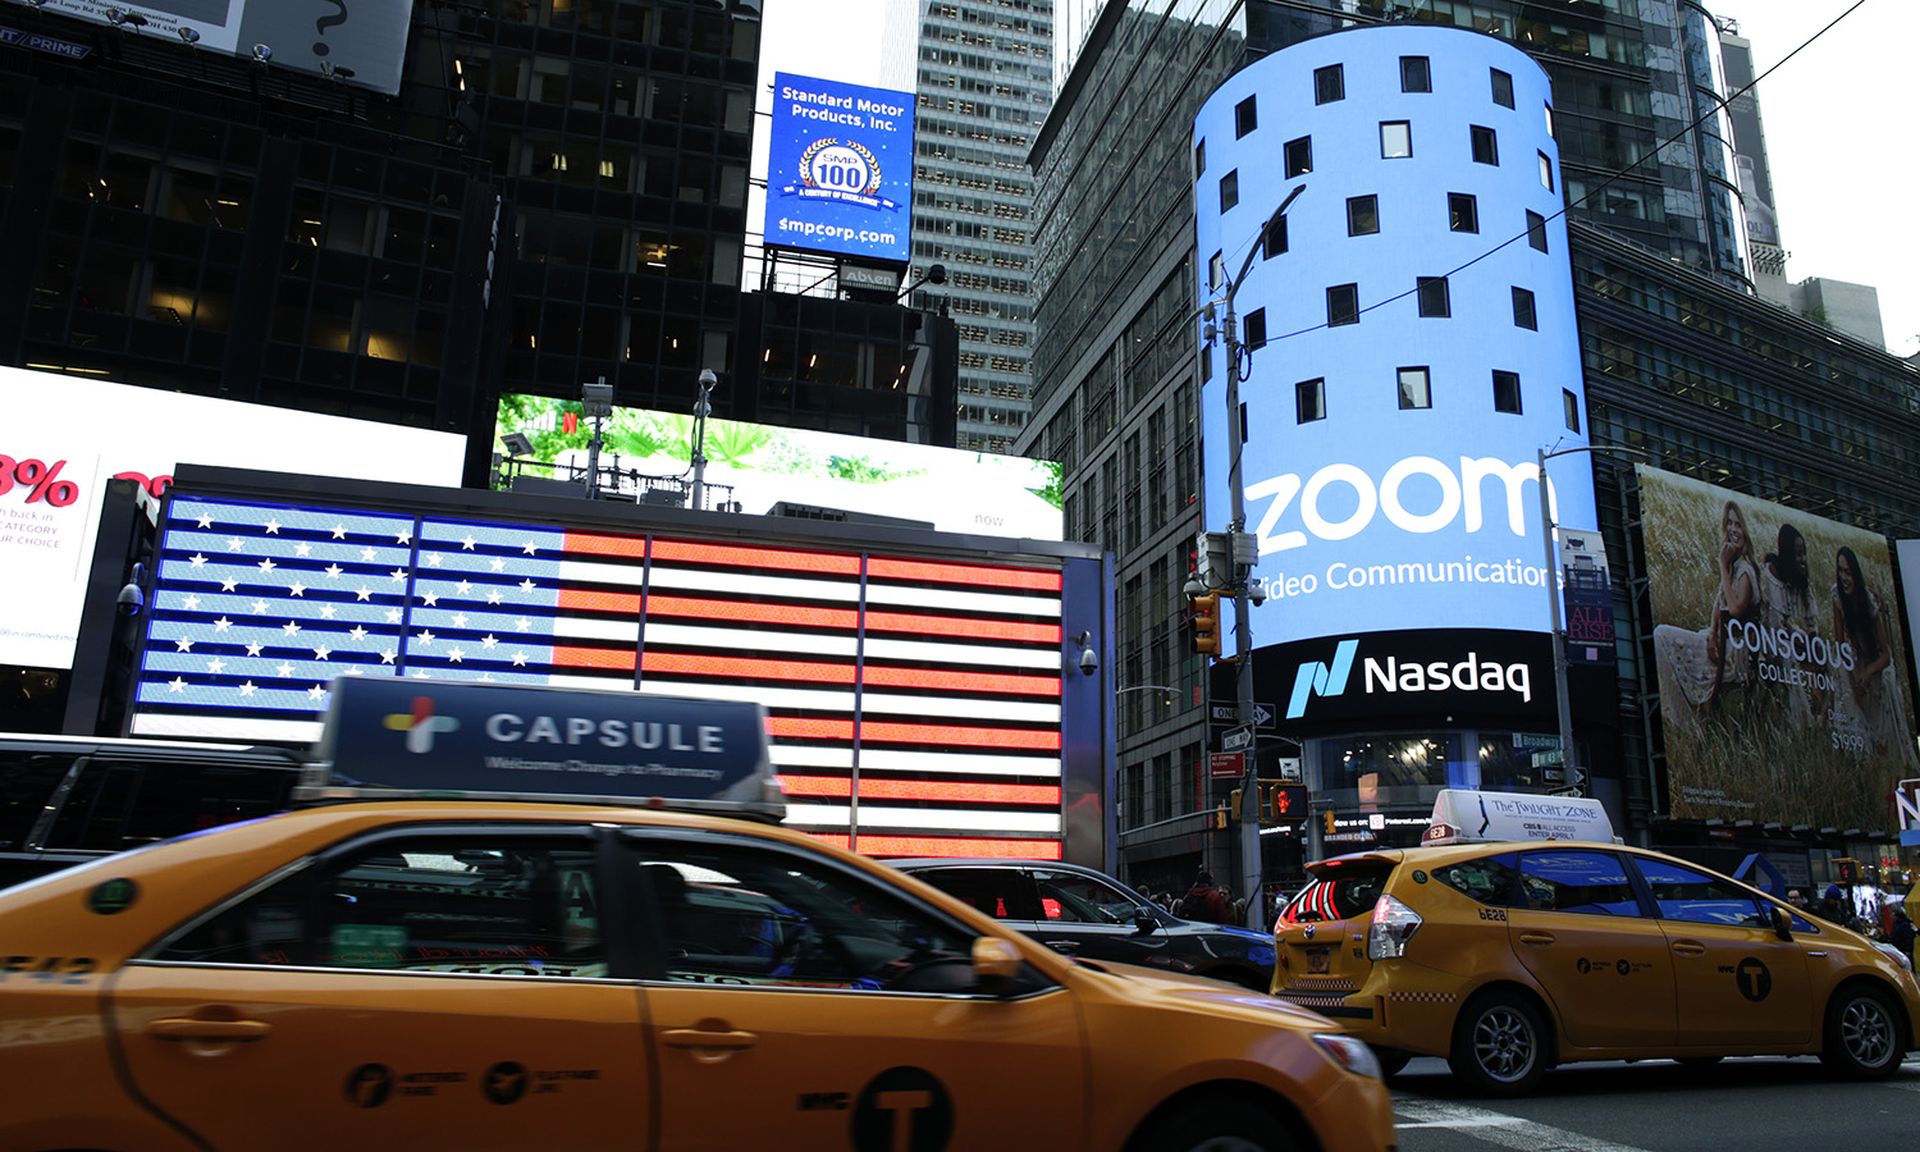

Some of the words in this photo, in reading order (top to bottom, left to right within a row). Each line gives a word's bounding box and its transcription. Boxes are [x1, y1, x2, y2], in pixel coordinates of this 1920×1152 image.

[82, 5, 95, 14] Rd
[29, 37, 82, 57] PRIME
[782, 86, 852, 110] Standard
[857, 99, 904, 118] Motor
[792, 104, 866, 129] Products,
[870, 116, 898, 132] Inc.
[823, 153, 858, 165] SMP
[818, 164, 860, 188] 100
[779, 217, 896, 245] smpcorp.com
[10, 507, 38, 520] back
[42, 514, 54, 522] in
[1243, 455, 1559, 558] zoom
[974, 513, 1004, 527] now
[17, 537, 61, 548] CHOICE
[1260, 571, 1318, 602] ideo
[1326, 555, 1565, 590] Communications
[1571, 606, 1611, 624] ALL
[1569, 622, 1614, 641] RISE
[1727, 617, 1855, 671] CONSCIOUS
[1364, 652, 1531, 702] Nasdaq
[1759, 660, 1835, 692] COLLECTION
[1217, 706, 1238, 719] ONE
[485, 713, 724, 753] CAPSULE
[1522, 735, 1560, 750] Broadway
[484, 756, 563, 772] Welcome
[564, 759, 625, 776] Change
[650, 763, 725, 781] Pharmacy
[1492, 800, 1514, 812] The
[1563, 805, 1598, 819] ZONE
[1528, 830, 1550, 838] ENTER
[1717, 965, 1735, 975] NYC
[1743, 966, 1763, 996] T
[876, 1090, 930, 1152] T
